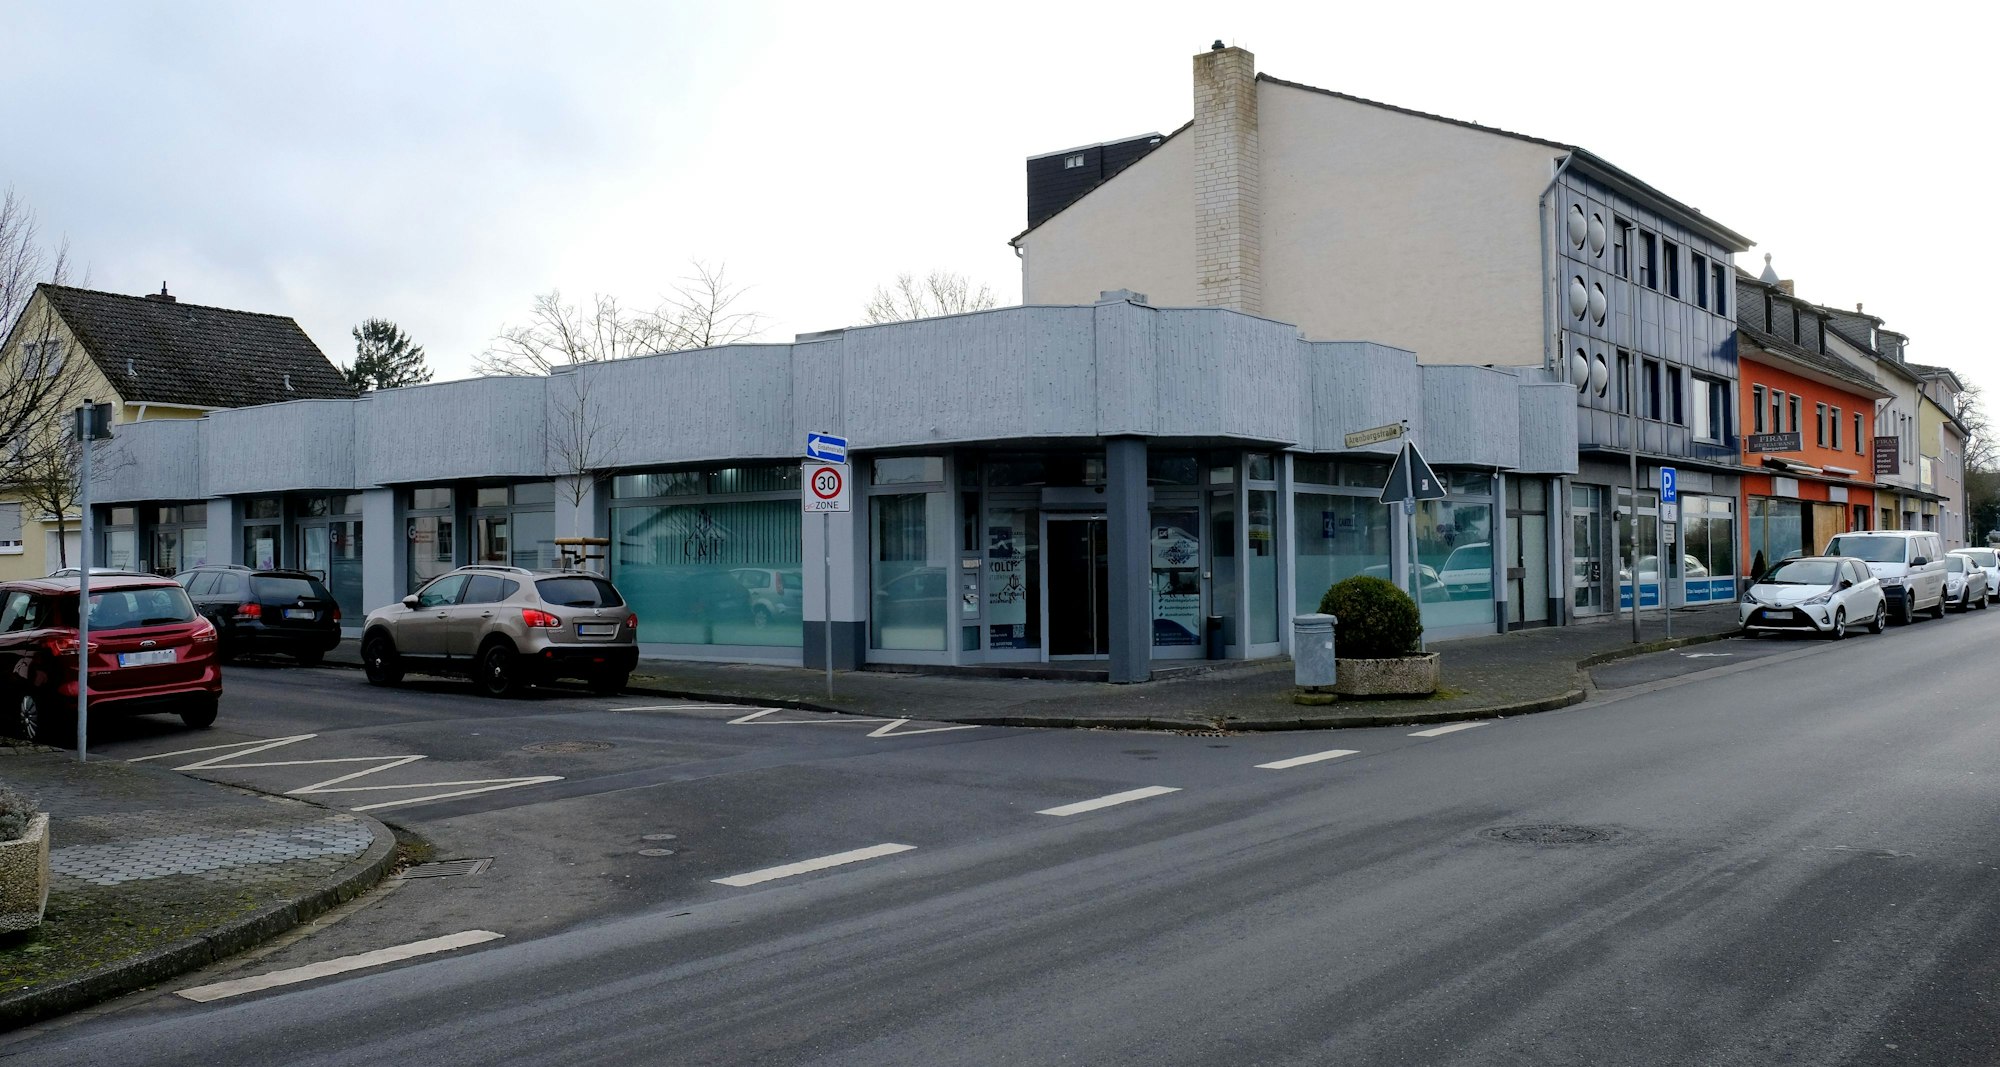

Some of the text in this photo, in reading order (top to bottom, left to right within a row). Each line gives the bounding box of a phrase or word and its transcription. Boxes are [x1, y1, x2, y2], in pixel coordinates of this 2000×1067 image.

[1759, 435, 1789, 443] FIRAT
[818, 476, 835, 490] 30
[1664, 472, 1672, 498] P
[816, 501, 839, 510] ZONE
